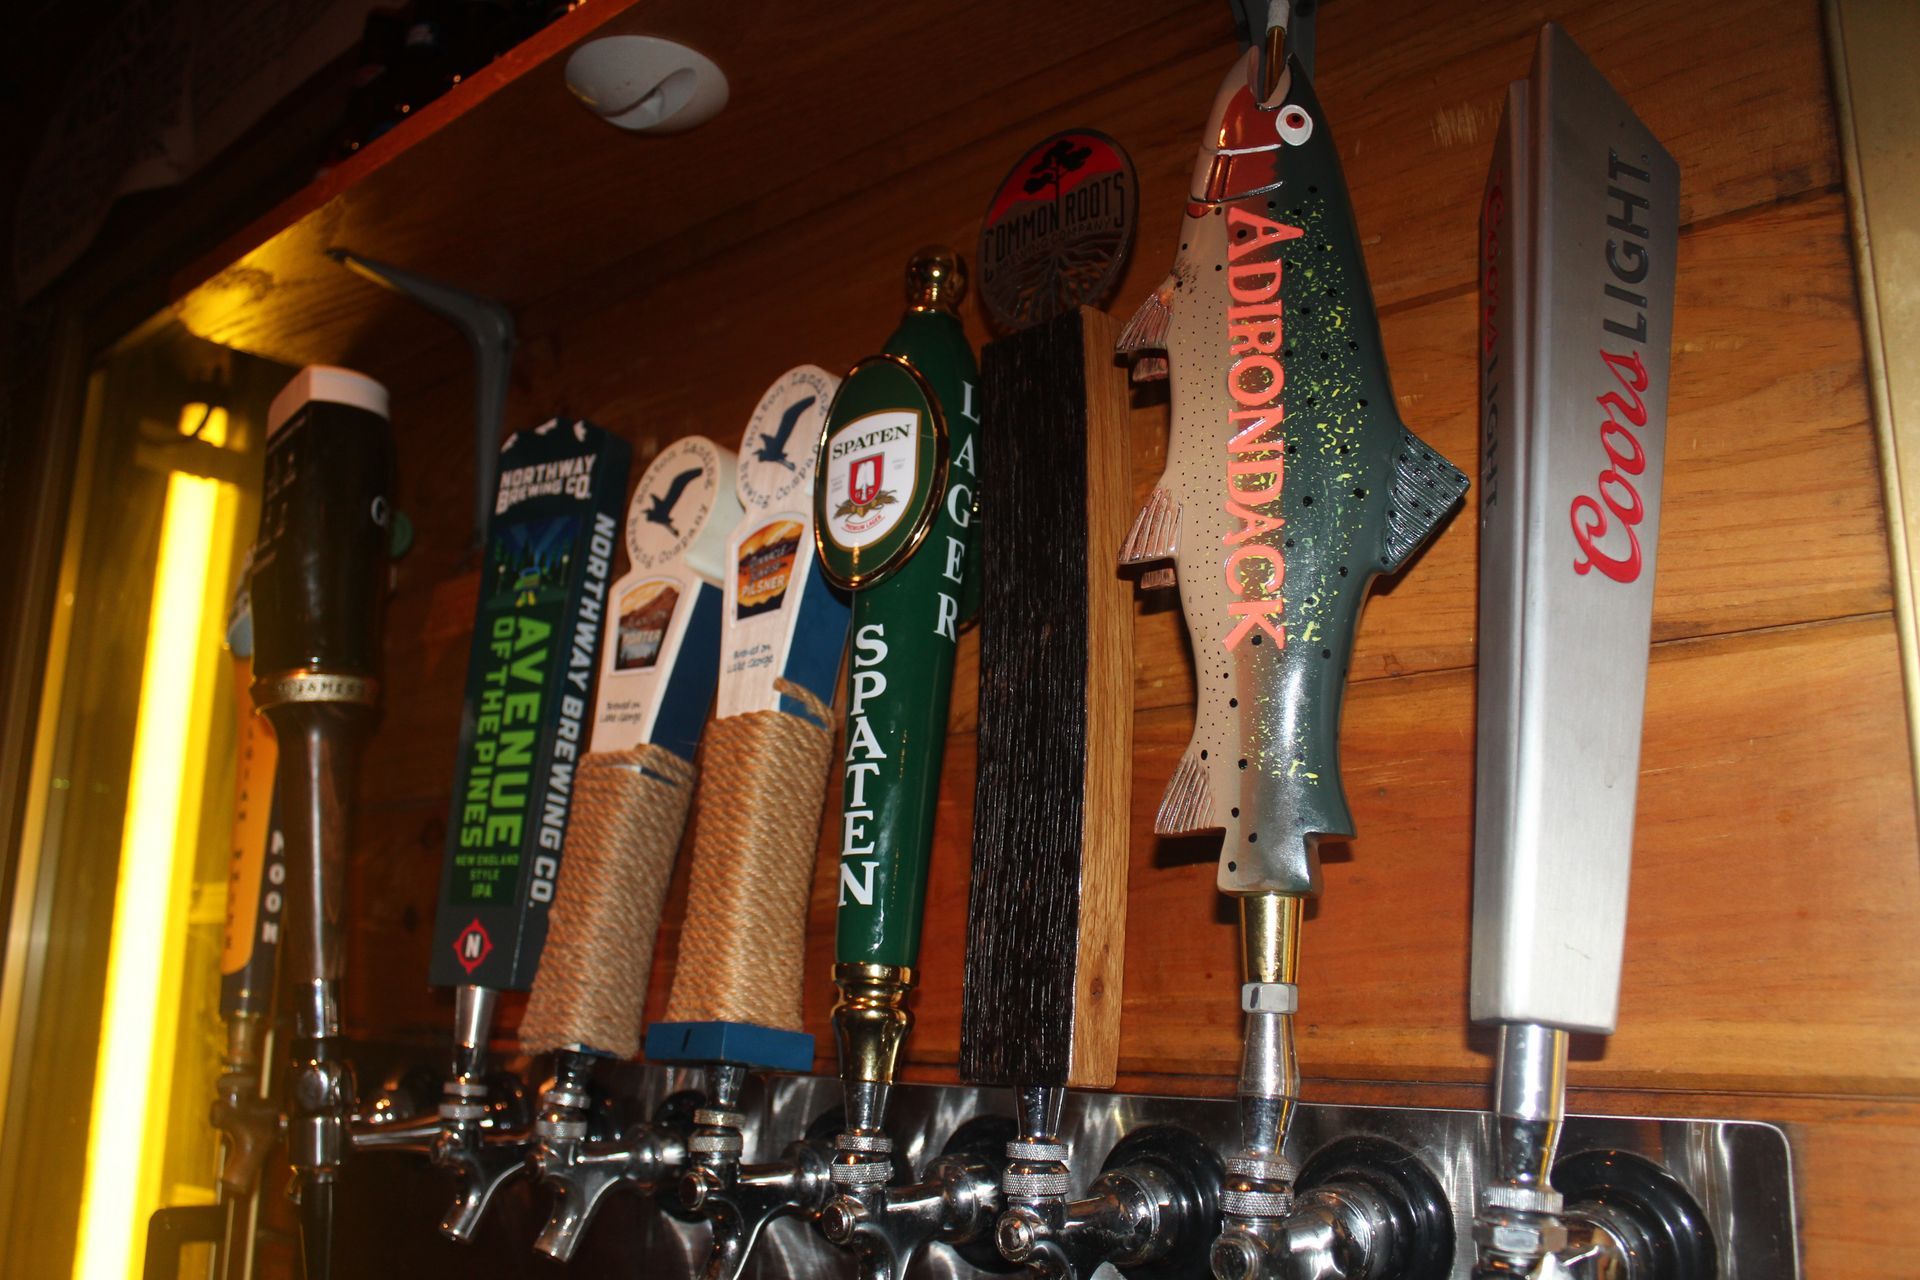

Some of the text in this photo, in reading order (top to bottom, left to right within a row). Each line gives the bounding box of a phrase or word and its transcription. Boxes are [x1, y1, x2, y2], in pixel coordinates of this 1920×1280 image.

[984, 172, 1125, 282] COMMON ROOTS
[1570, 146, 1651, 584] Coors LIGHT
[500, 453, 597, 488] NORTHWAY
[832, 423, 912, 460] SPATEN
[1222, 206, 1304, 651] ADIRONDACK
[1484, 353, 1499, 509] LIGHT
[495, 479, 563, 515] BREWING
[934, 380, 980, 643] LAGER
[742, 575, 786, 597] PILSNER
[460, 616, 515, 848] OF THE PINES
[484, 615, 551, 847] AVENUE
[528, 511, 617, 908] NORTHWAY BREWING CO.
[838, 623, 888, 907] SPATEN
[455, 853, 519, 867] NEW ENGLAND
[470, 868, 500, 881] STYLE
[472, 883, 493, 898] IPA
[465, 932, 481, 959] N
